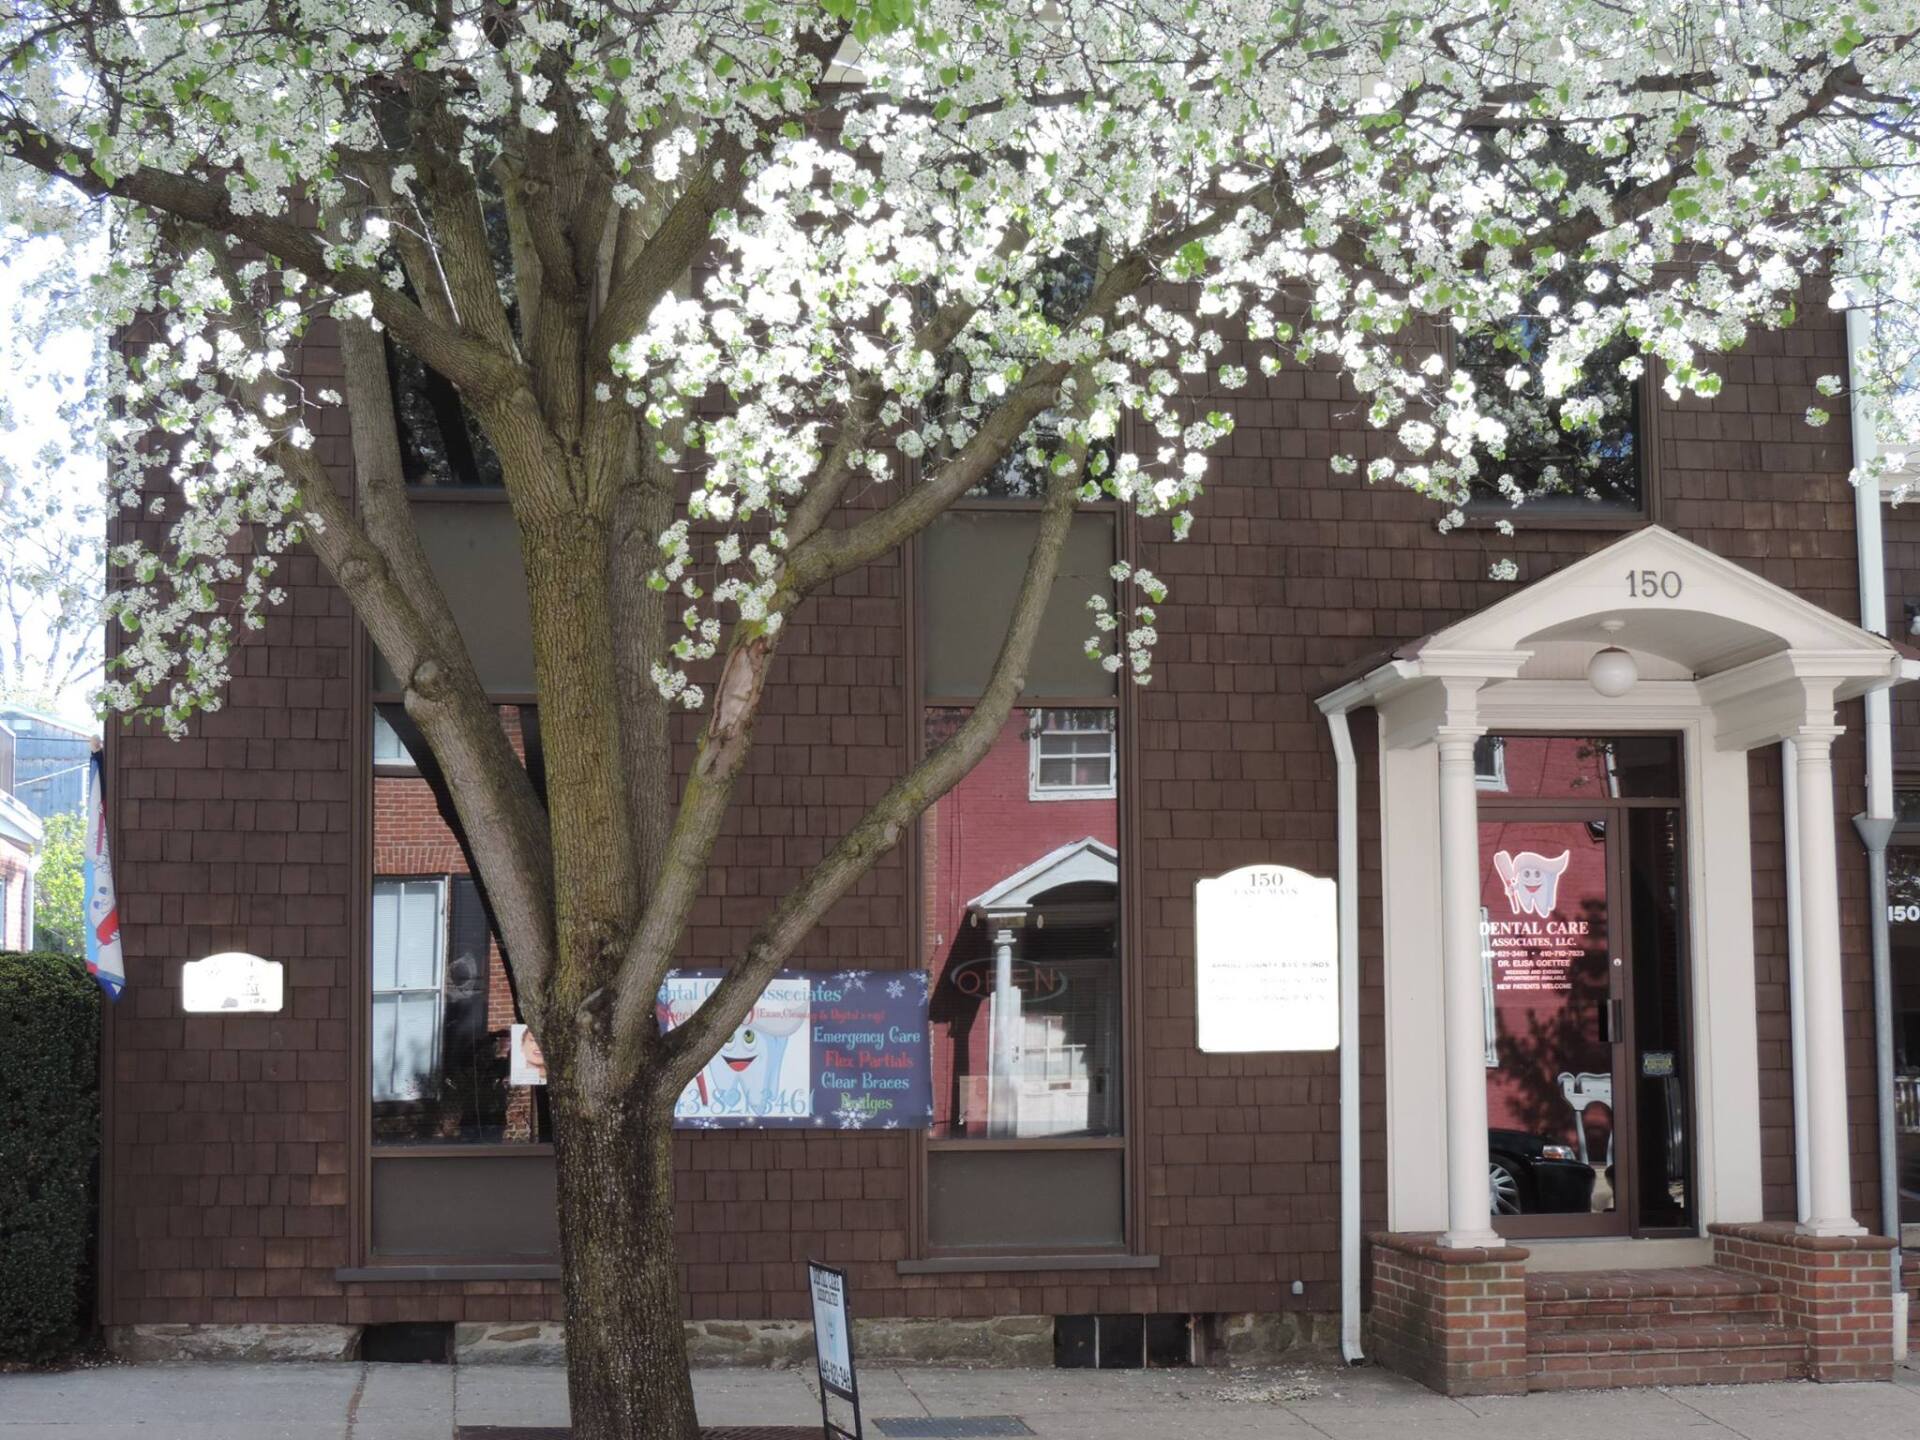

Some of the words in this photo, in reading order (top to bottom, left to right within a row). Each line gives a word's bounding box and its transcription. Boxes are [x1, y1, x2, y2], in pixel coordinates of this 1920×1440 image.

[1625, 570, 1682, 598] 150
[1250, 873, 1284, 887] 150
[1888, 905, 1920, 921] 150
[1480, 922, 1543, 935] DENTAL
[1546, 921, 1589, 935] CARE
[1492, 938, 1553, 947] ASSOCIATES,
[1555, 938, 1577, 946] LLC.
[814, 1026, 885, 1050] Emergency
[888, 1026, 921, 1043] Care
[859, 1050, 914, 1068] Partials
[821, 1071, 857, 1089] Clear
[862, 1071, 910, 1089] Braces
